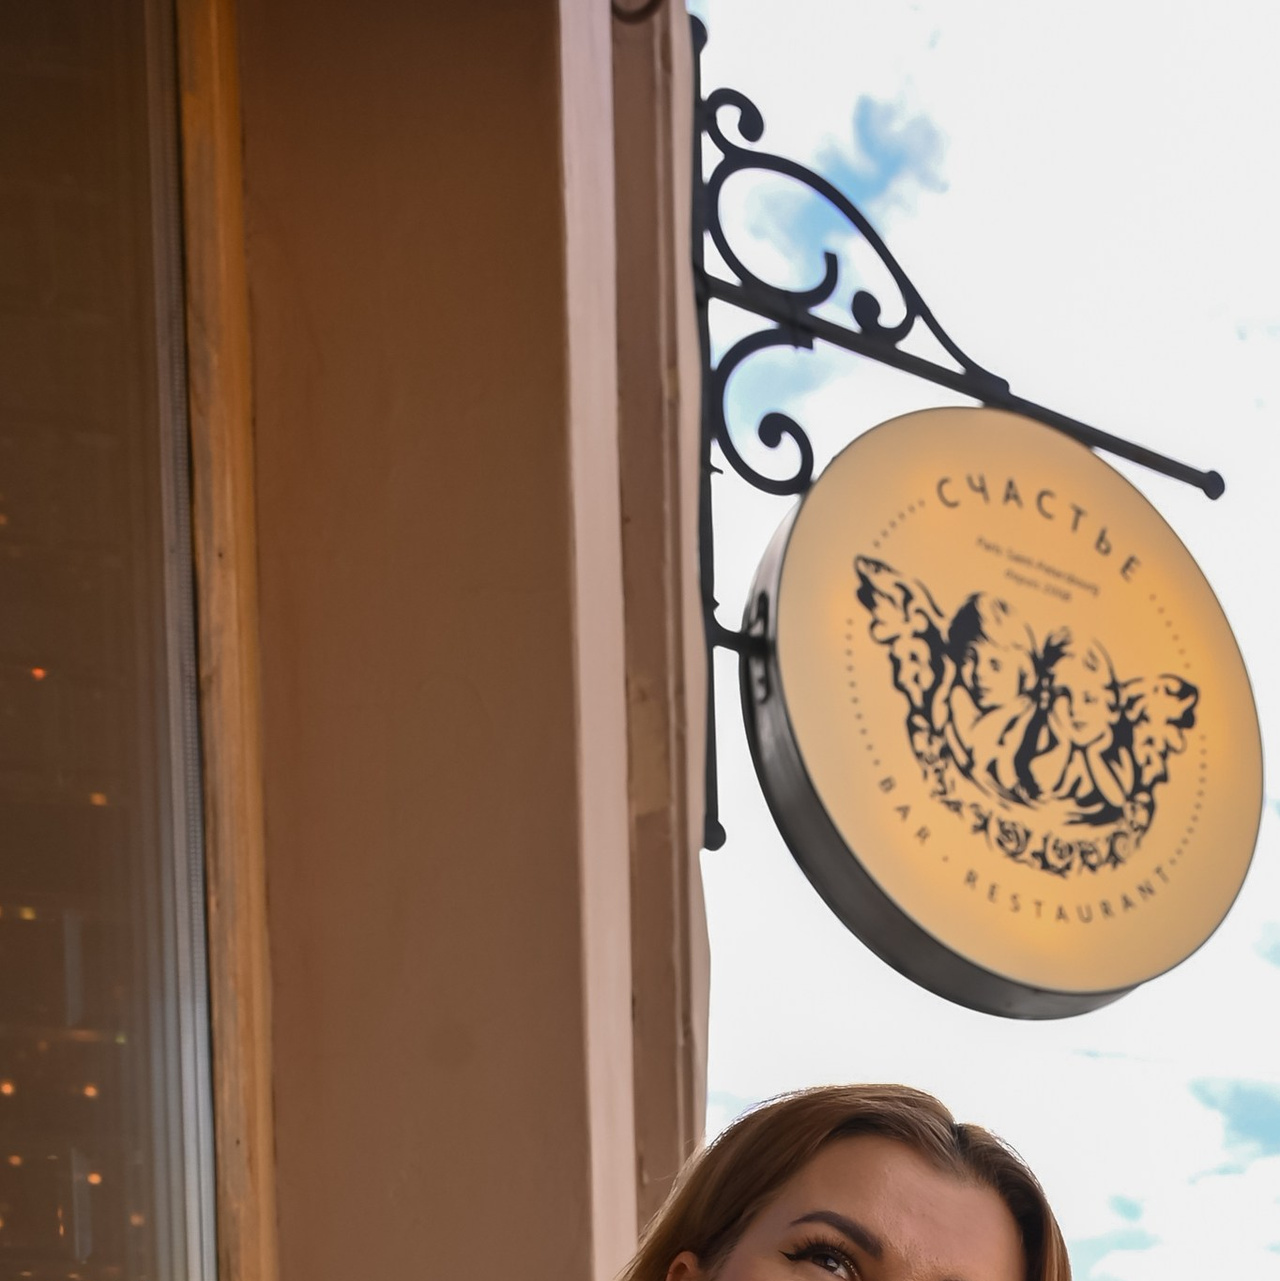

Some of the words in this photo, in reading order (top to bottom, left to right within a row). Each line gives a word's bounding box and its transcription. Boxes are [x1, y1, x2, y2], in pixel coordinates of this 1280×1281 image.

[936, 473, 1140, 581] СЧАСТЬЕ
[879, 776, 931, 845] BAR
[964, 864, 1170, 923] RESTAURANT
